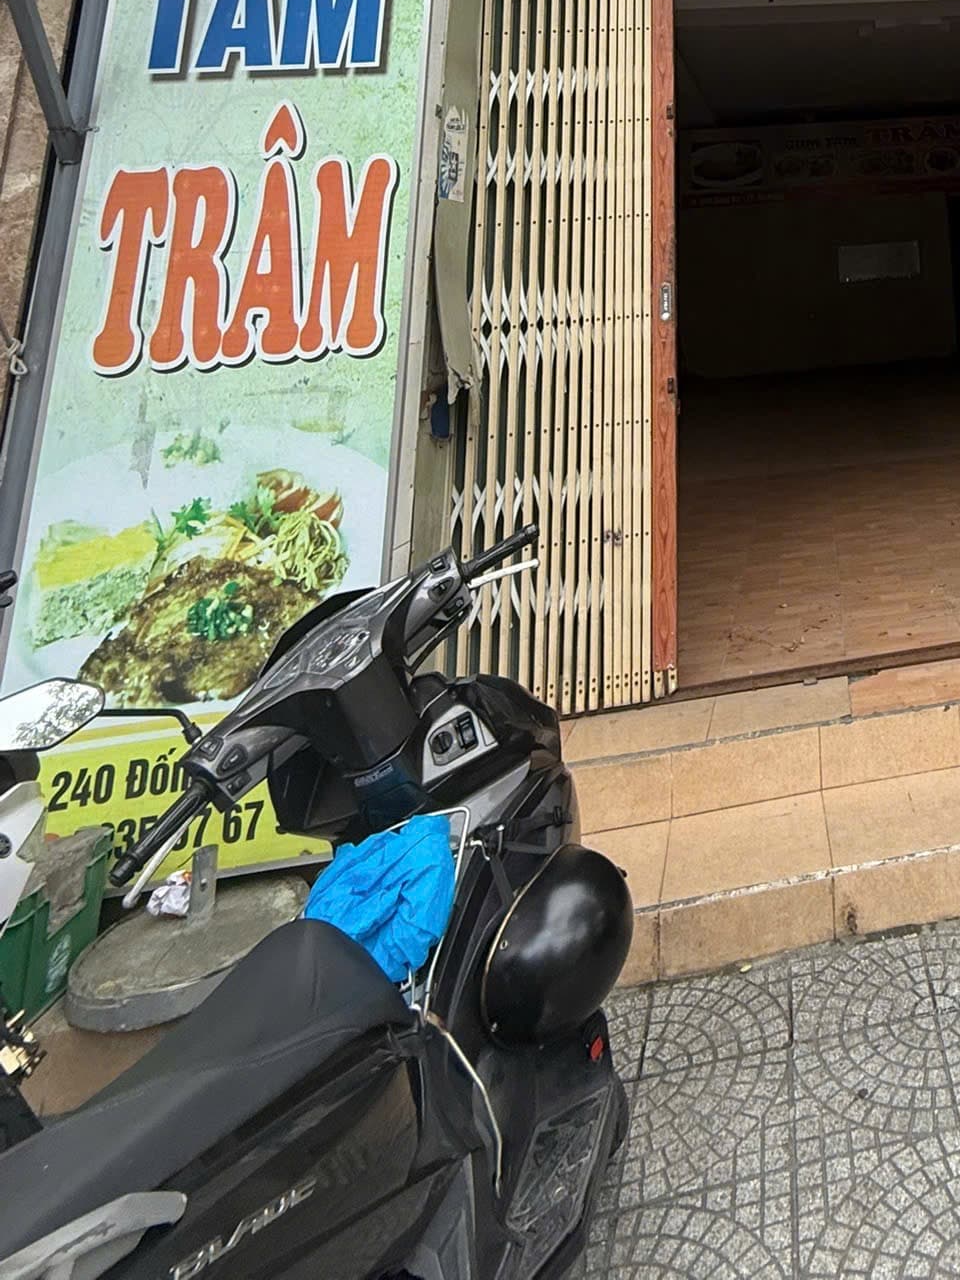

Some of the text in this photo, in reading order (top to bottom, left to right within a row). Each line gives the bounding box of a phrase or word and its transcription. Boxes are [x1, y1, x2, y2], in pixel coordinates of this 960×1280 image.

[92, 100, 400, 376] TRÂM
[48, 747, 194, 813] 240 Đốn
[222, 800, 265, 844] 67
